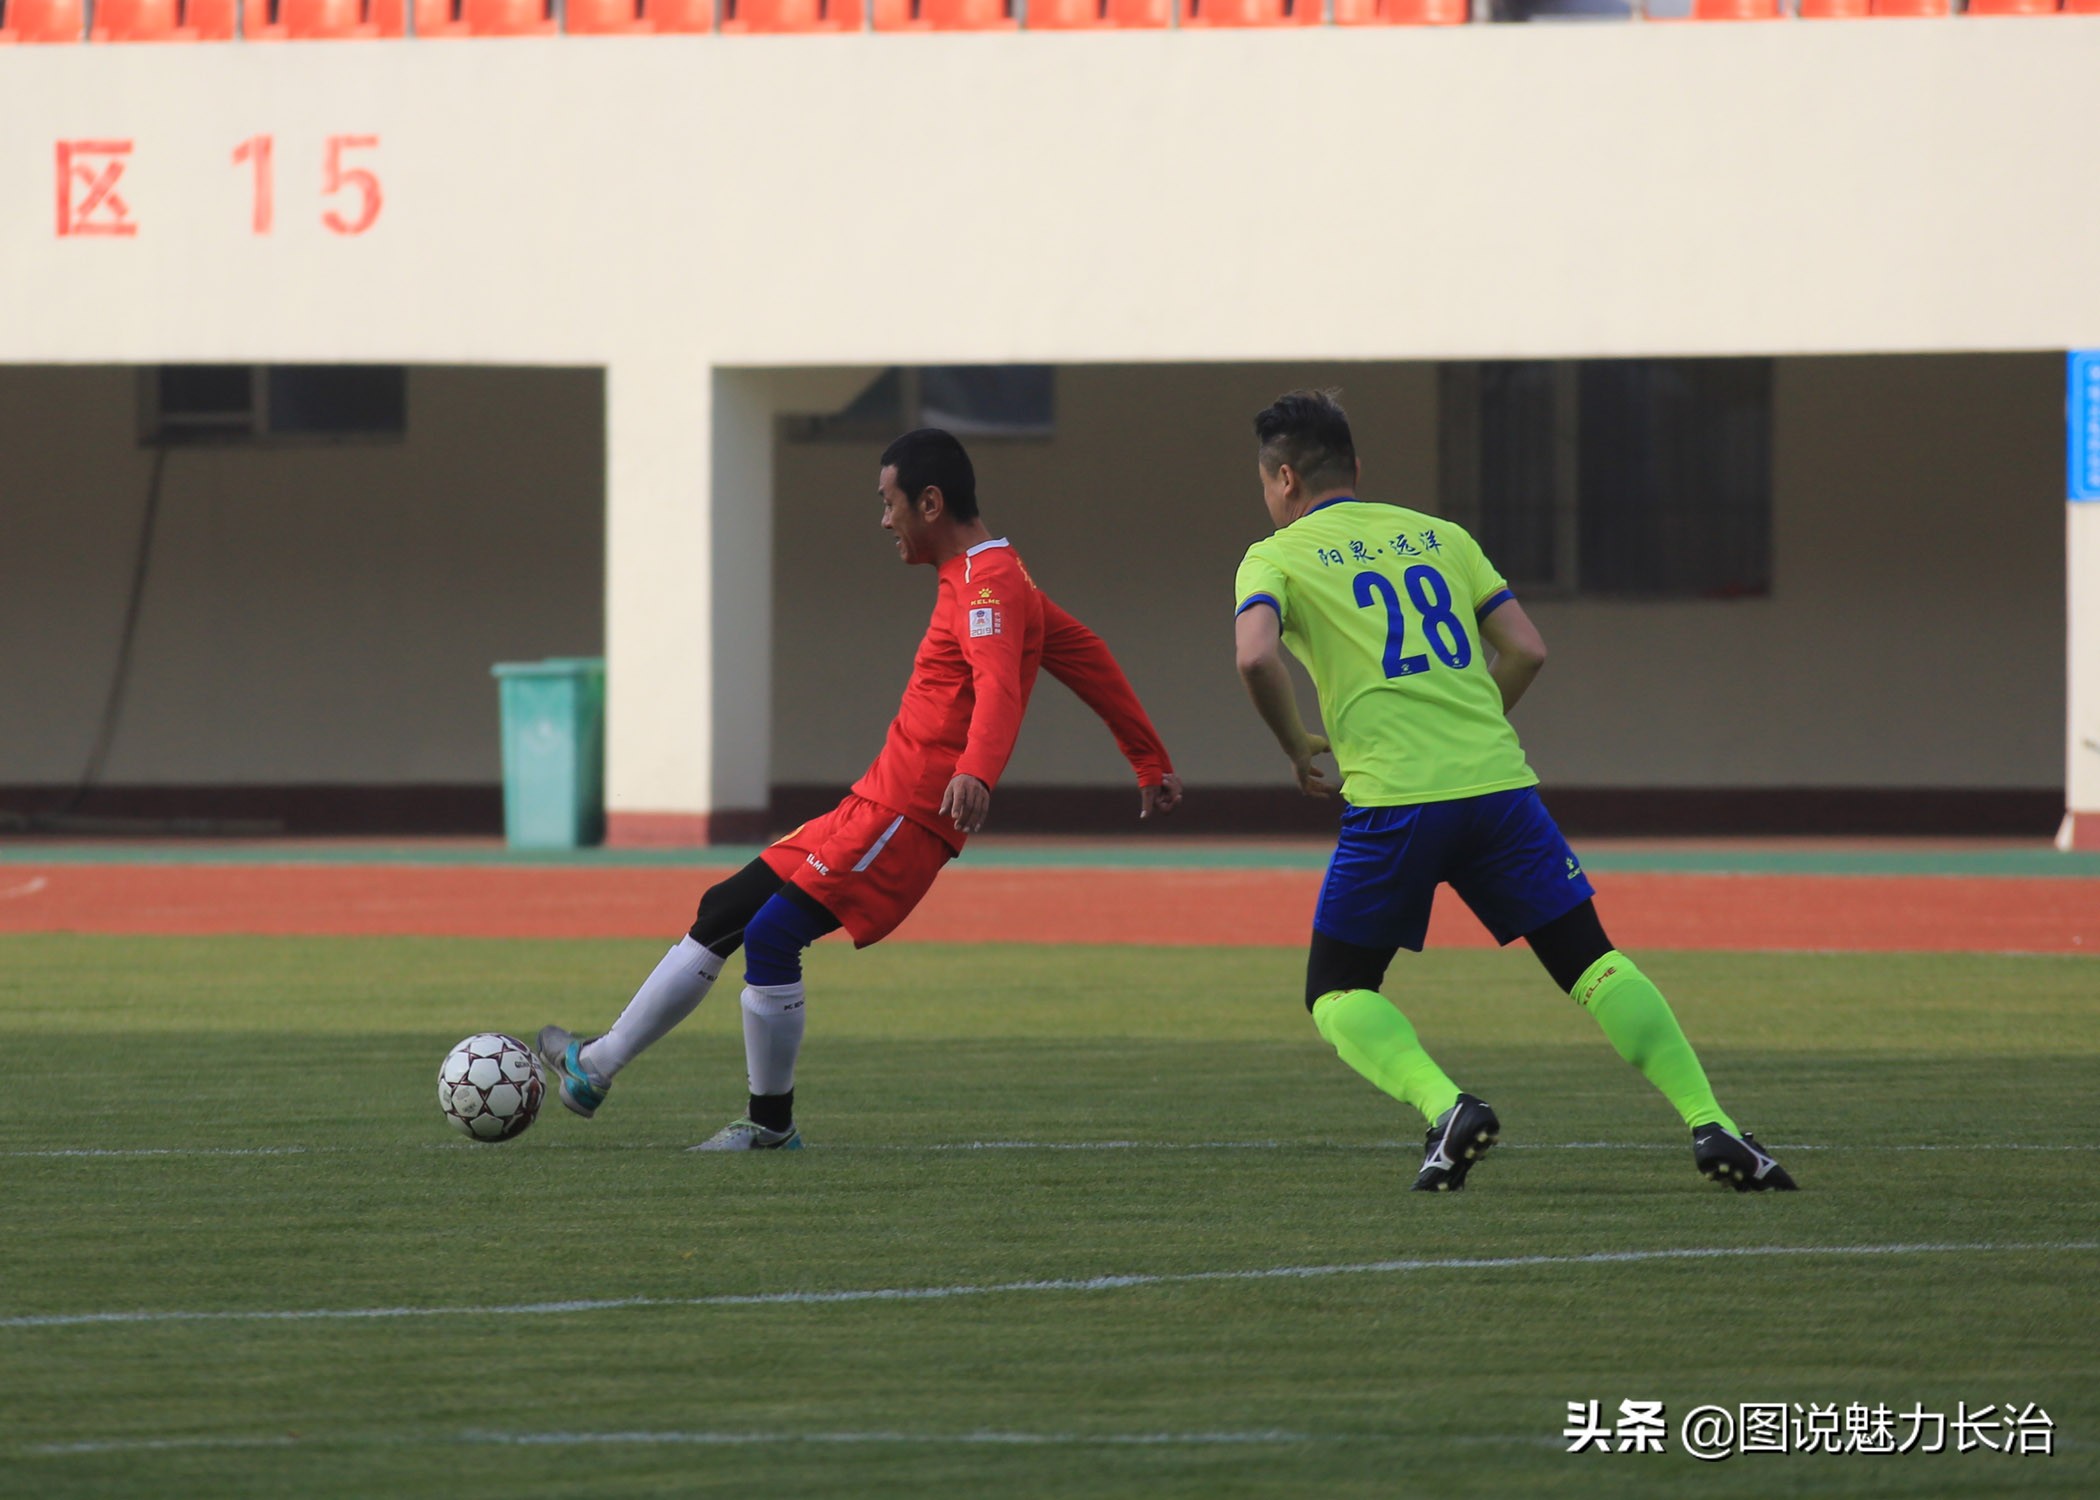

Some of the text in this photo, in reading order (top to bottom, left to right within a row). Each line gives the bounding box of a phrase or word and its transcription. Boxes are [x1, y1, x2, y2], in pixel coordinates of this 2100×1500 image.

[56, 138, 138, 238] 区
[970, 598, 1001, 606] KELME
[1353, 564, 1472, 679] 28
